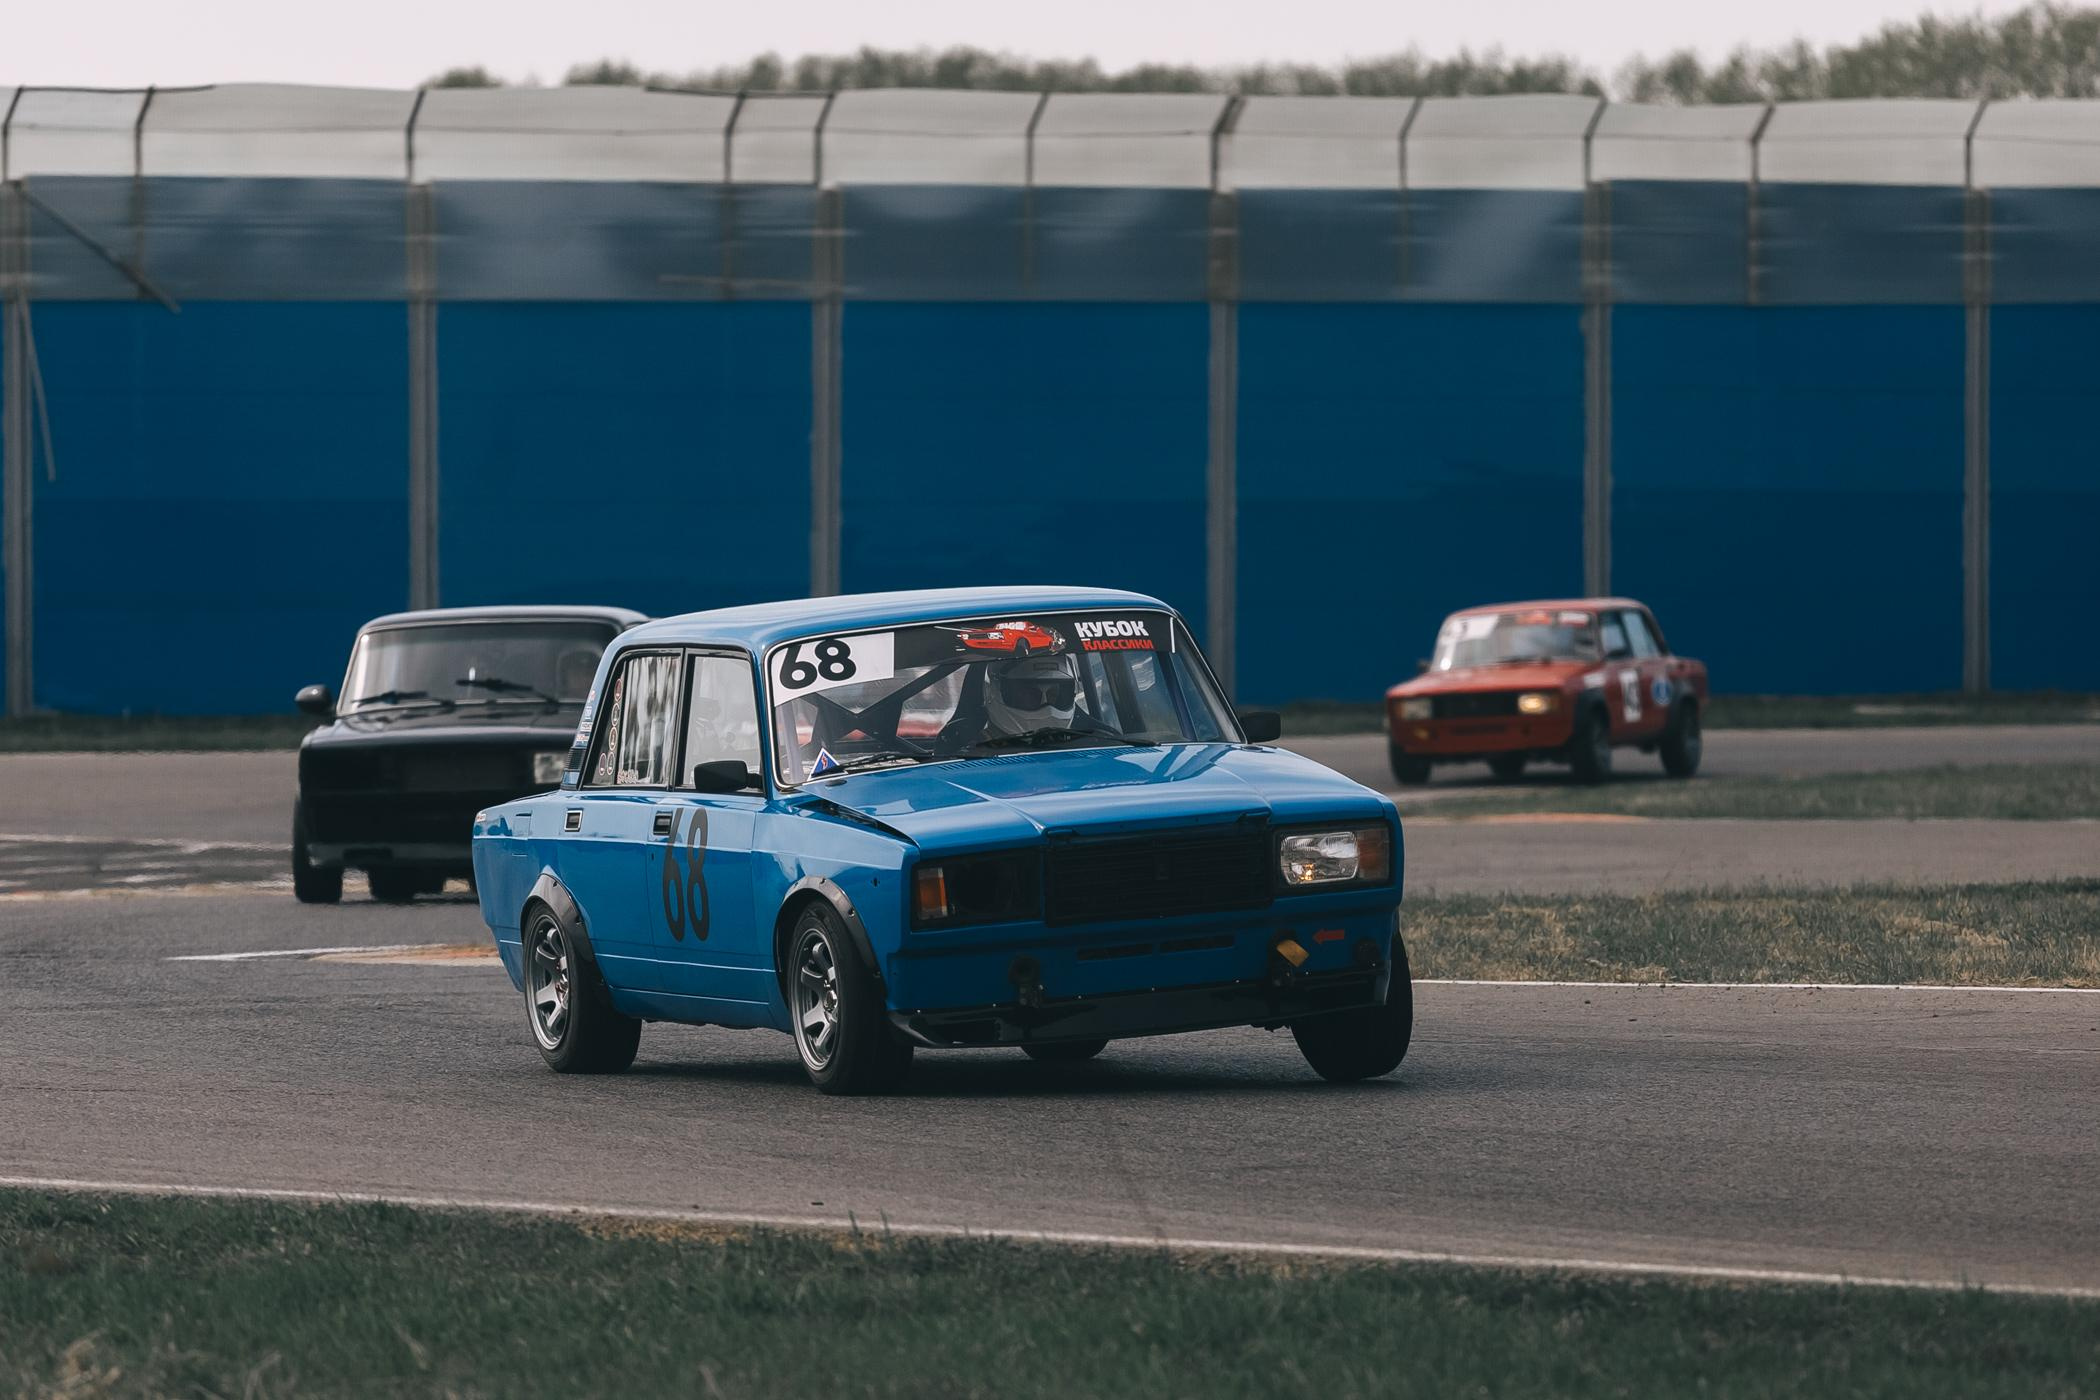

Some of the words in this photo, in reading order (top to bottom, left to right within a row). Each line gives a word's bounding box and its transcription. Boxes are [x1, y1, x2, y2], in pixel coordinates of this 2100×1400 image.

[1074, 620, 1149, 638] КУБОК
[1083, 638, 1154, 651] КЛАССИКИ
[779, 638, 857, 690] 68
[662, 807, 710, 942] 68
